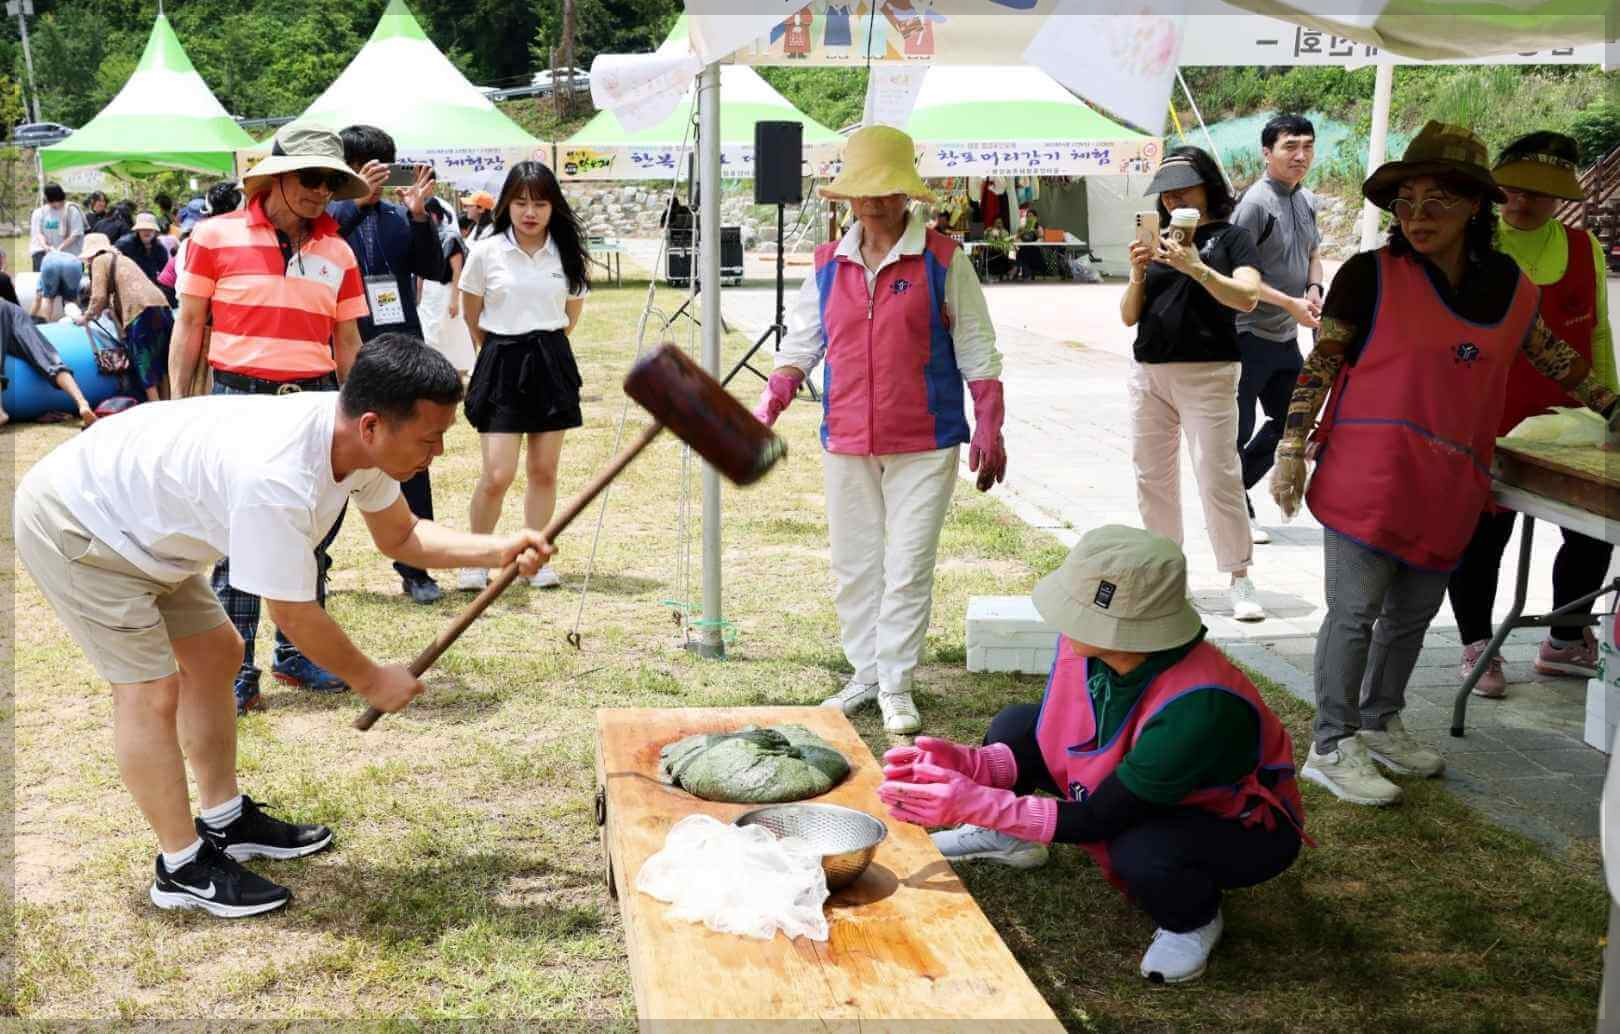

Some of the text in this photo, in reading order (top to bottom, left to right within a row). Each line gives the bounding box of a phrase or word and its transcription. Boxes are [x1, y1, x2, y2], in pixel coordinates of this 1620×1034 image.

[444, 155, 505, 172] 체험장
[630, 152, 675, 168] 한복
[1070, 148, 1111, 166] 체험
